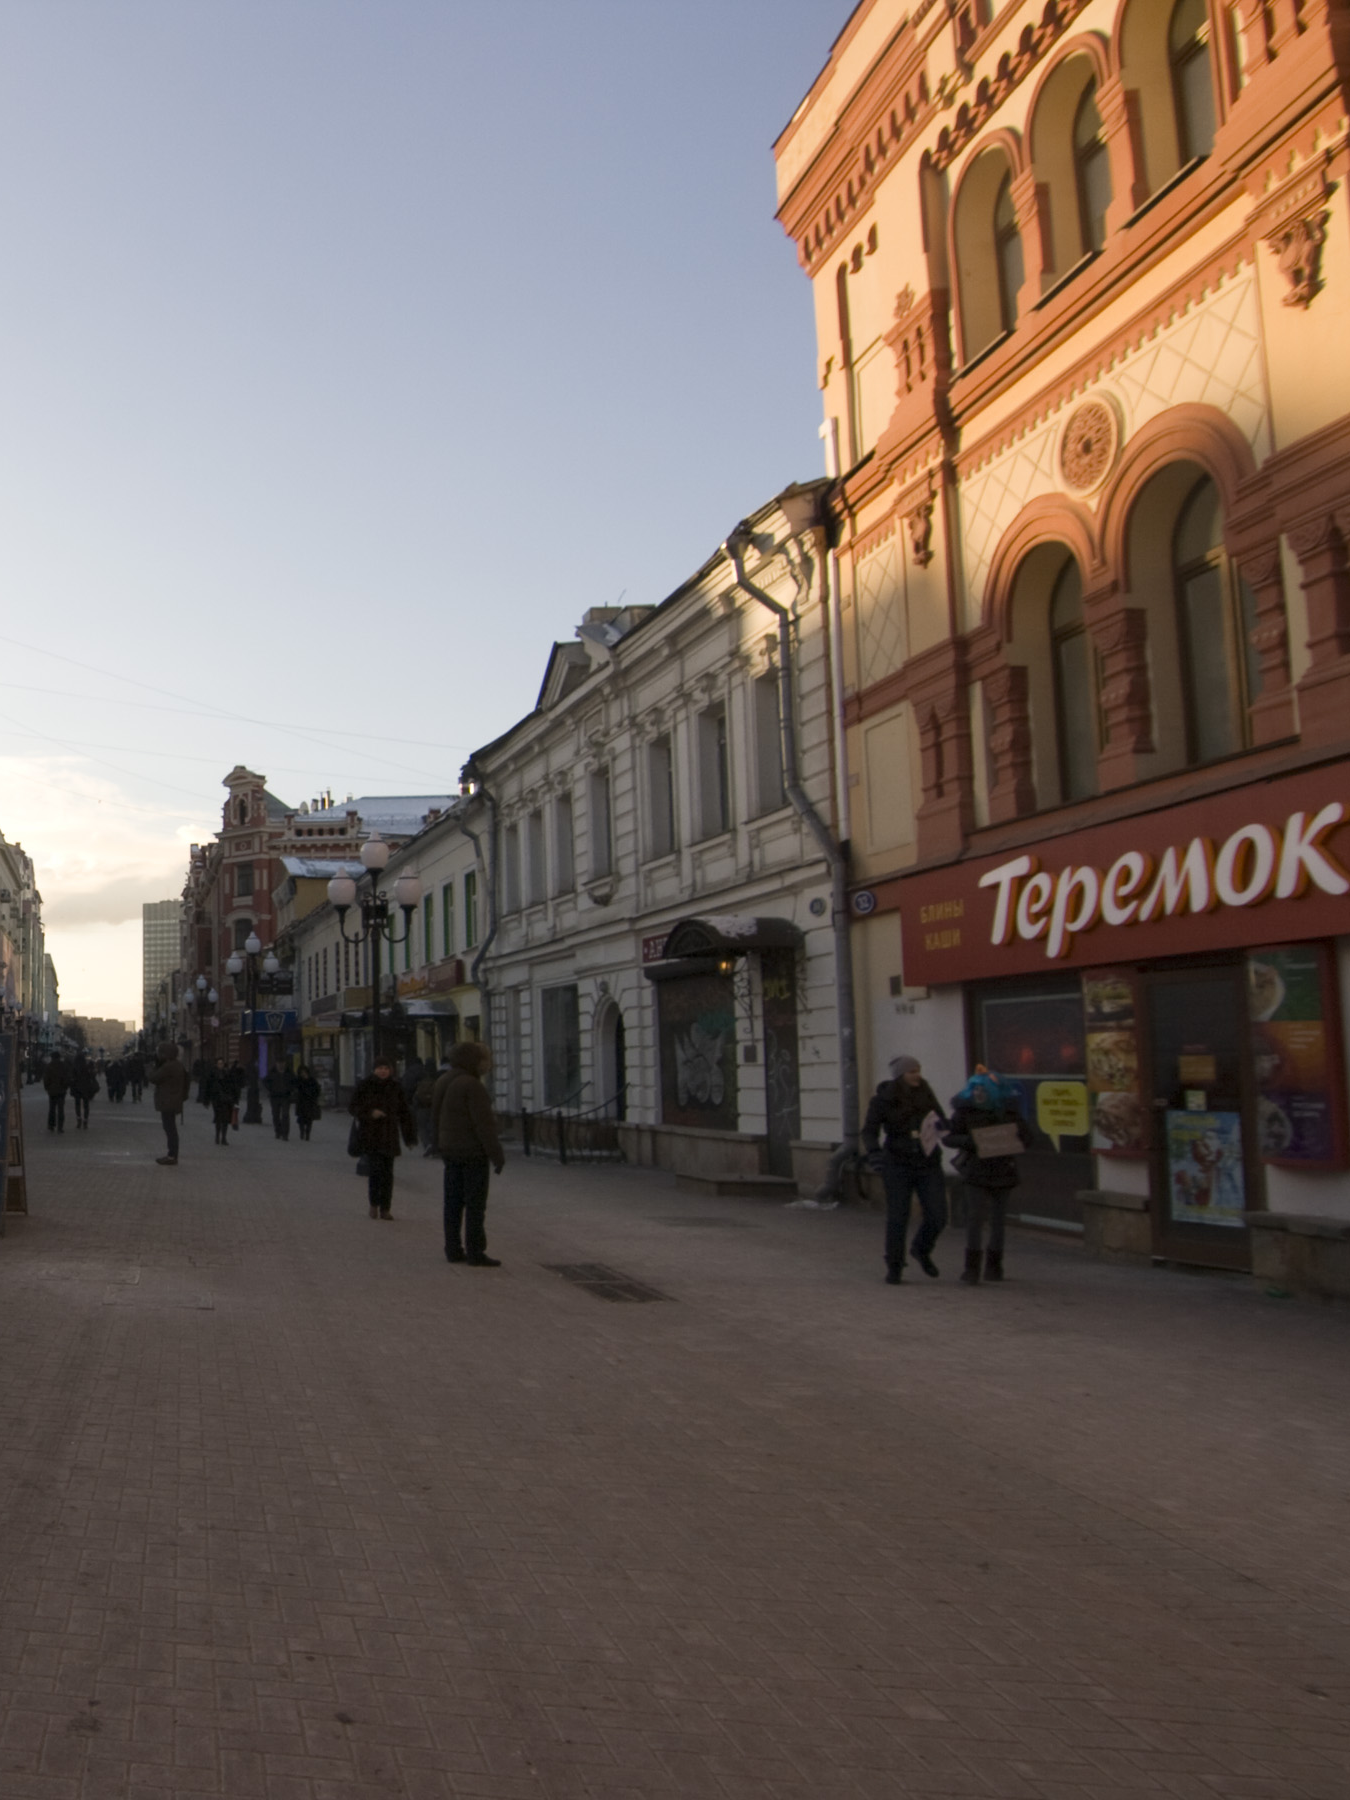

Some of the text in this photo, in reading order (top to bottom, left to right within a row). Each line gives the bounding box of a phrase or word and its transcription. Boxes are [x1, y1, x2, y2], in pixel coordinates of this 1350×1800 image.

[979, 802, 1350, 958] Теремок
[921, 898, 964, 924] БЛИНЫ
[924, 928, 961, 951] КАШИ
